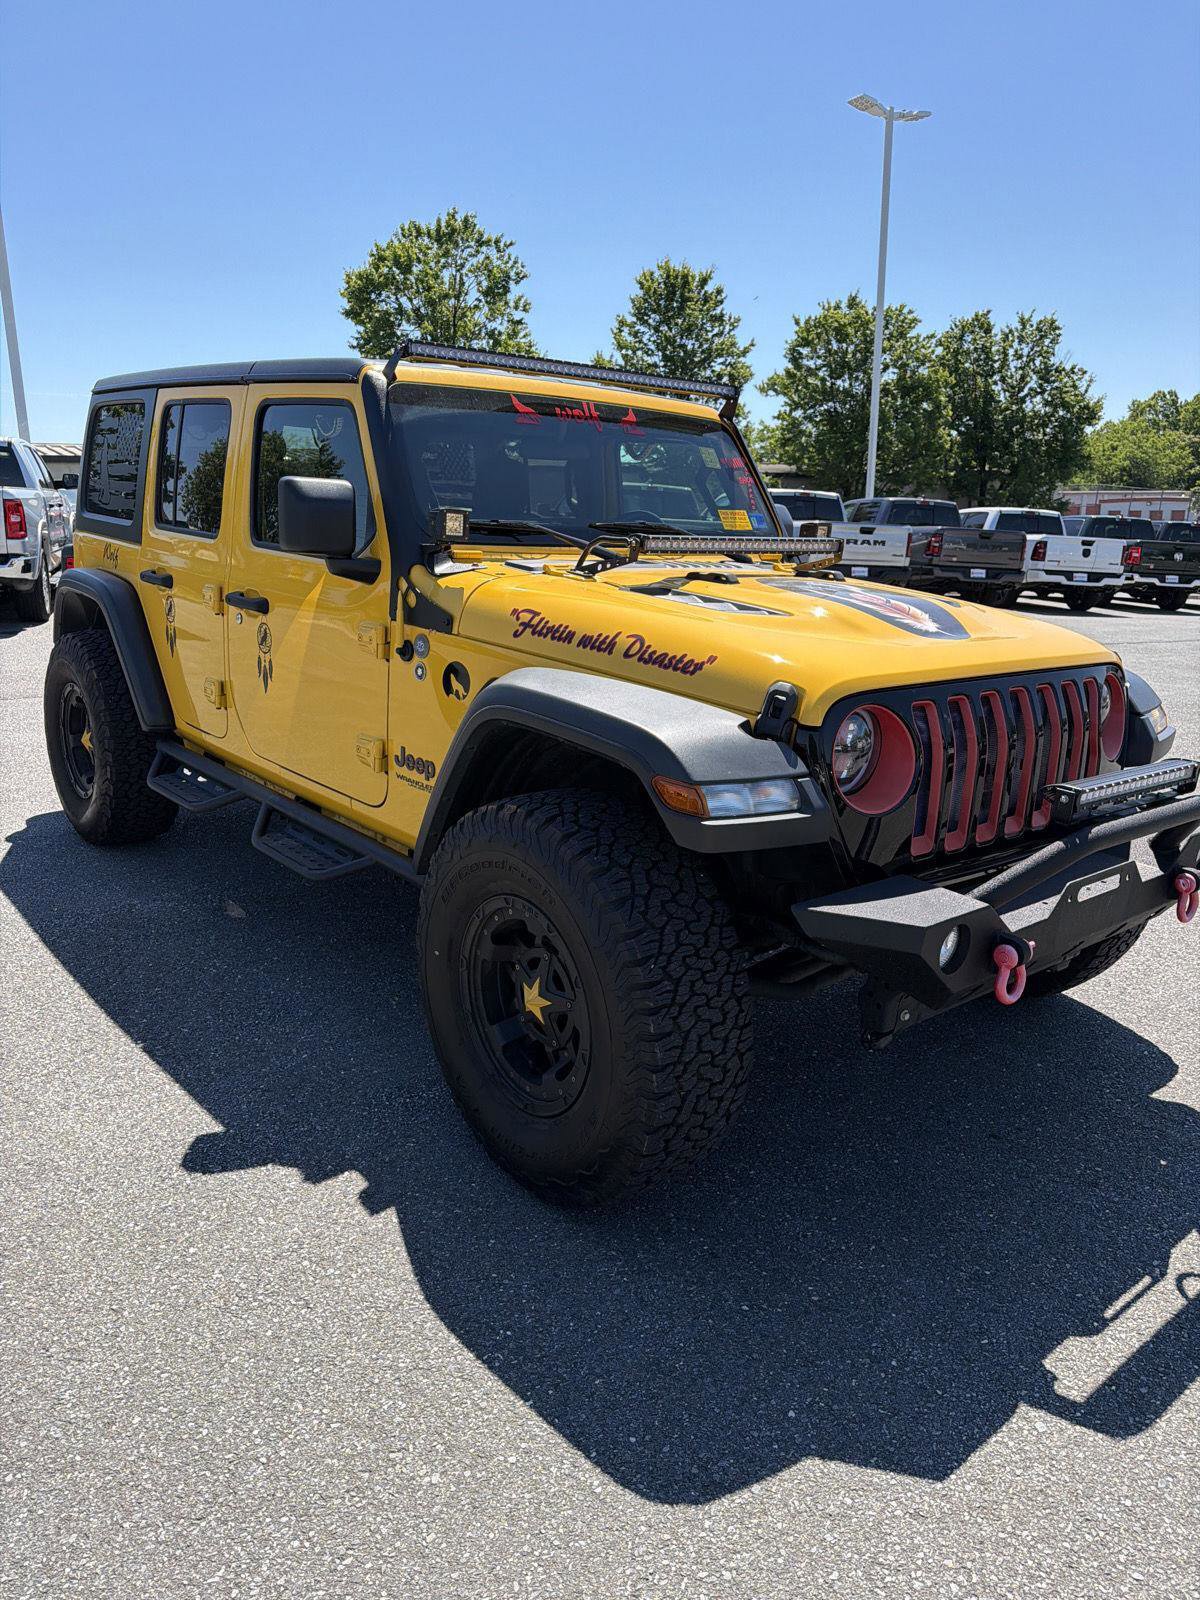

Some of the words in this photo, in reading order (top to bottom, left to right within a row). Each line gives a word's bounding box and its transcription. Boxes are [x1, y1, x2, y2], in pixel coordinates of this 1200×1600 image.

[845, 538, 887, 547] RAM
[576, 630, 623, 656] with
[622, 633, 719, 677] Disaster"
[394, 745, 436, 782] Jeep
